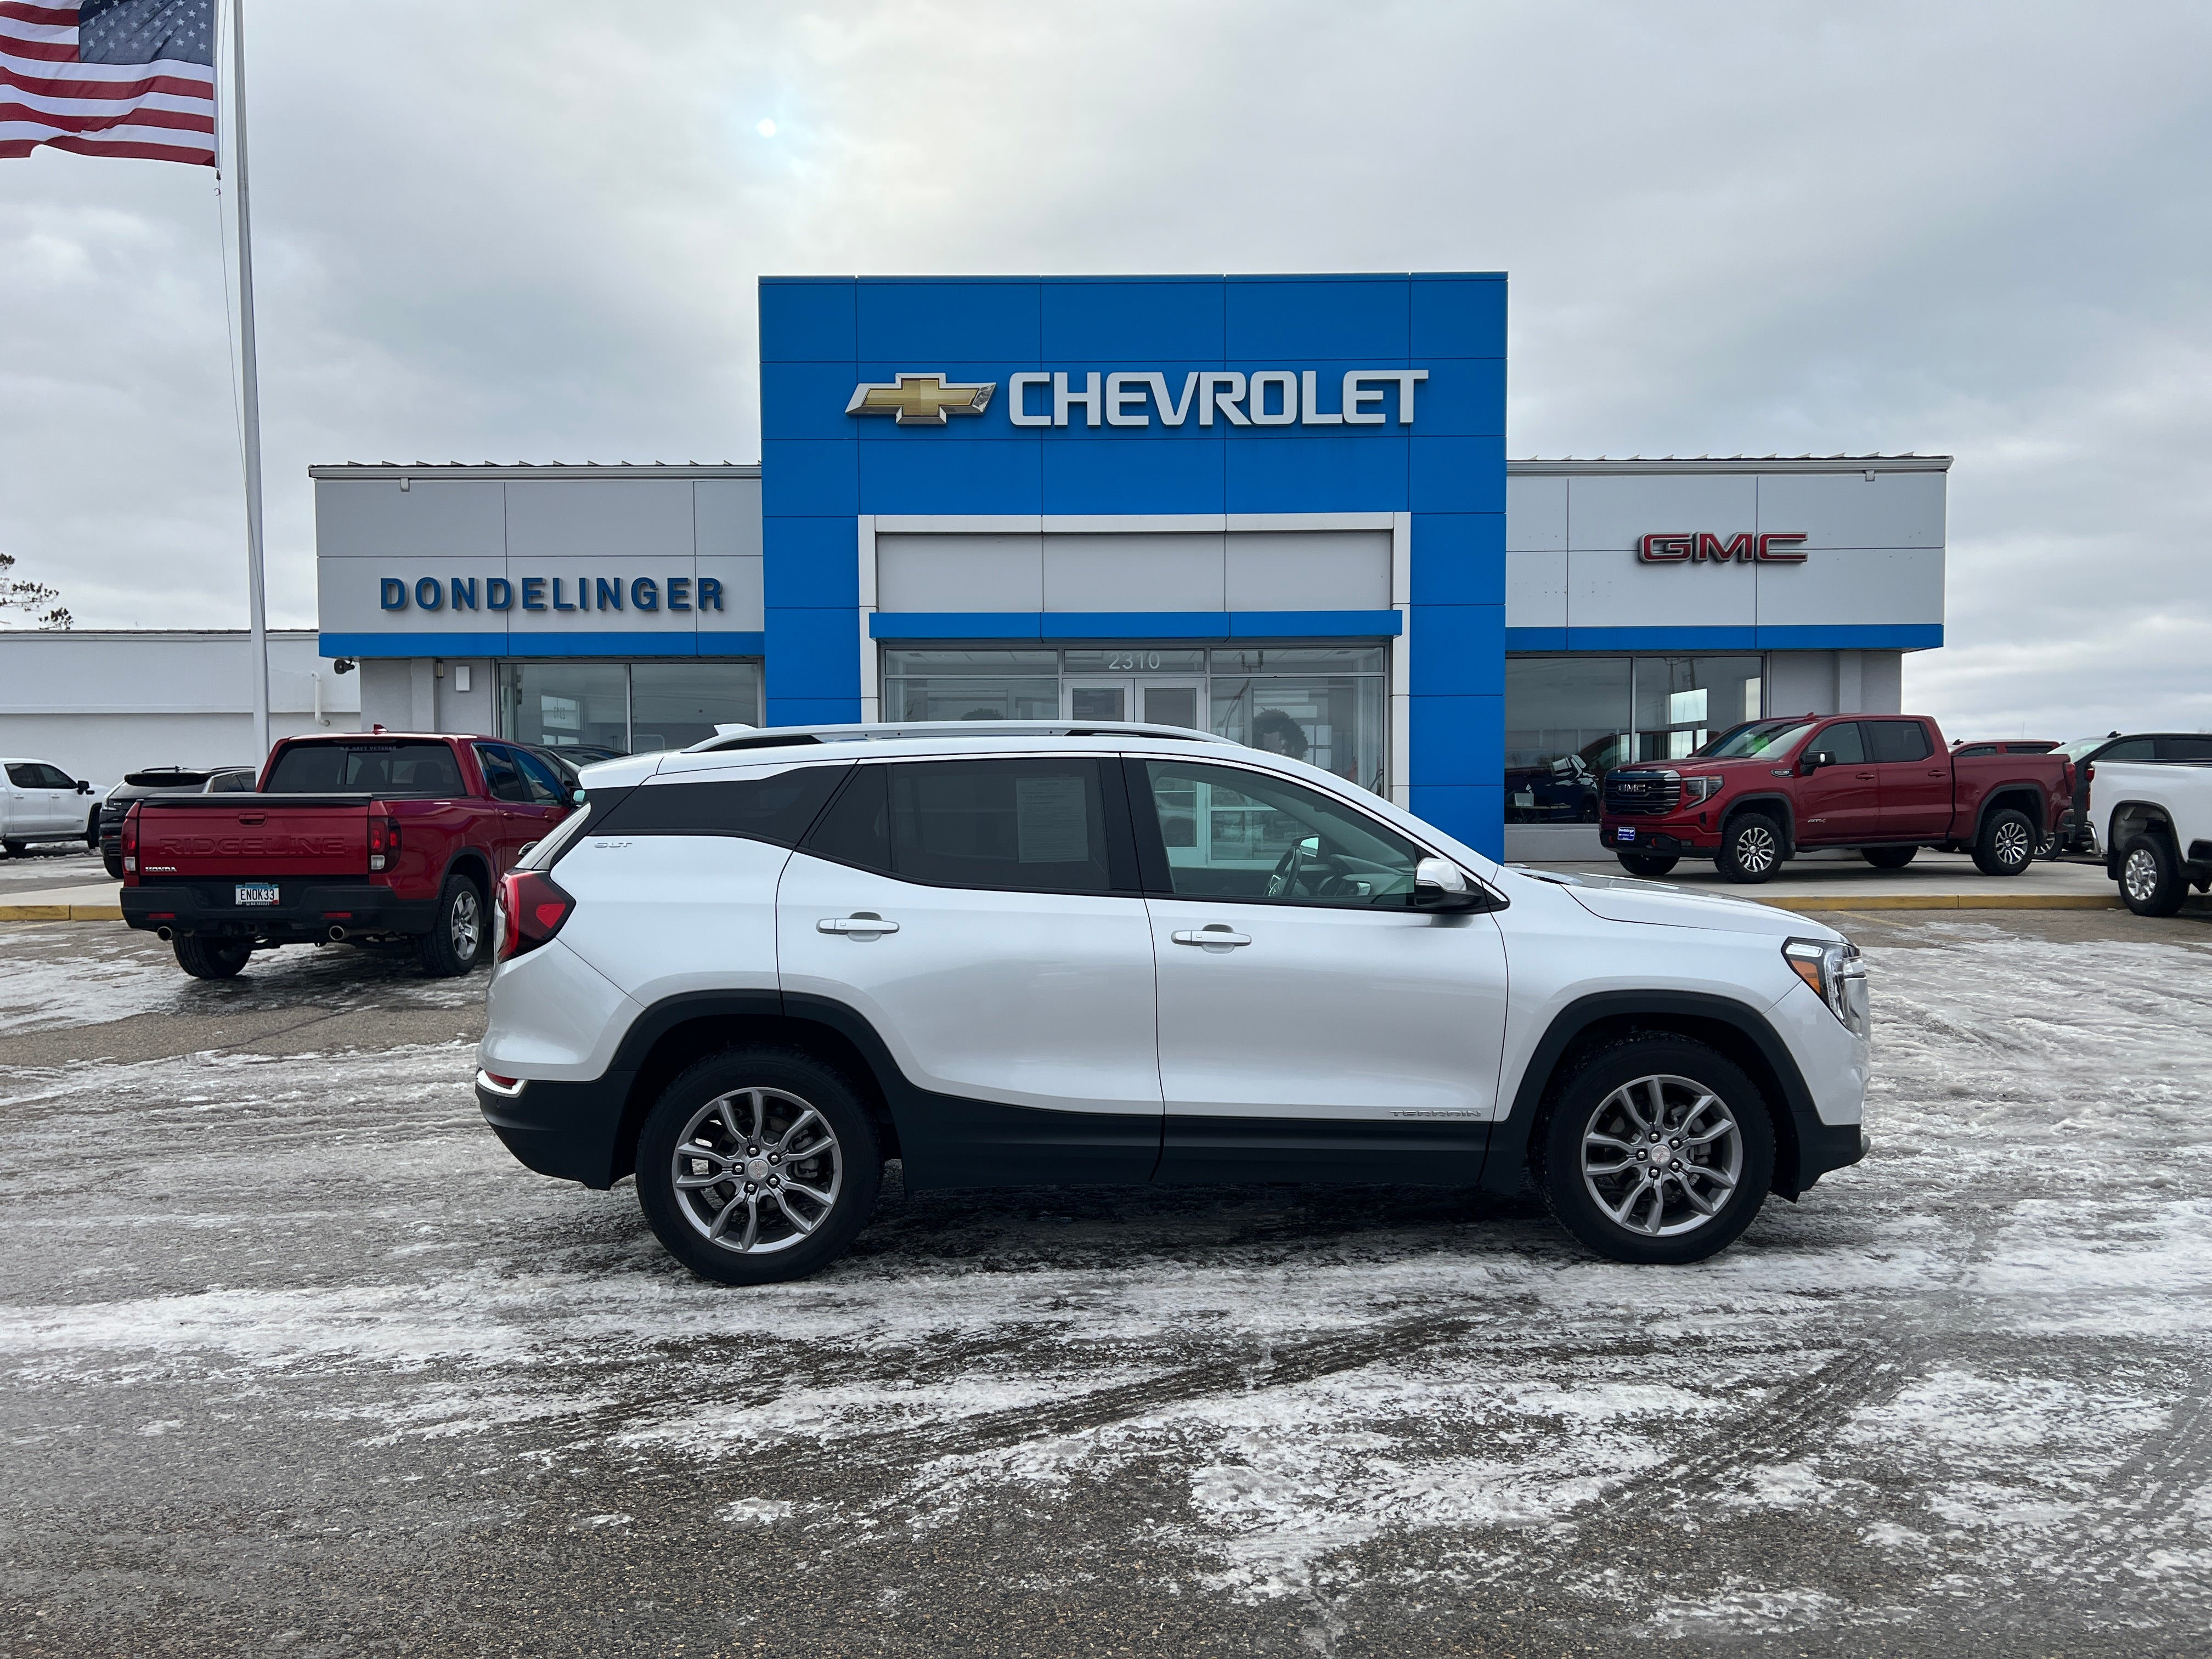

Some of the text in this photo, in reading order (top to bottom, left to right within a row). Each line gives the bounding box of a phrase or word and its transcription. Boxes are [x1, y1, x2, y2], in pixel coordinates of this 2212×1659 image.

[1009, 370, 1429, 426] CHEVROLET
[1639, 532, 1808, 562] GMC
[381, 577, 724, 611] DONDELINGER
[1109, 651, 1160, 669] 2310
[159, 838, 345, 855] RIDGELINE
[240, 889, 275, 901] ENOK33
